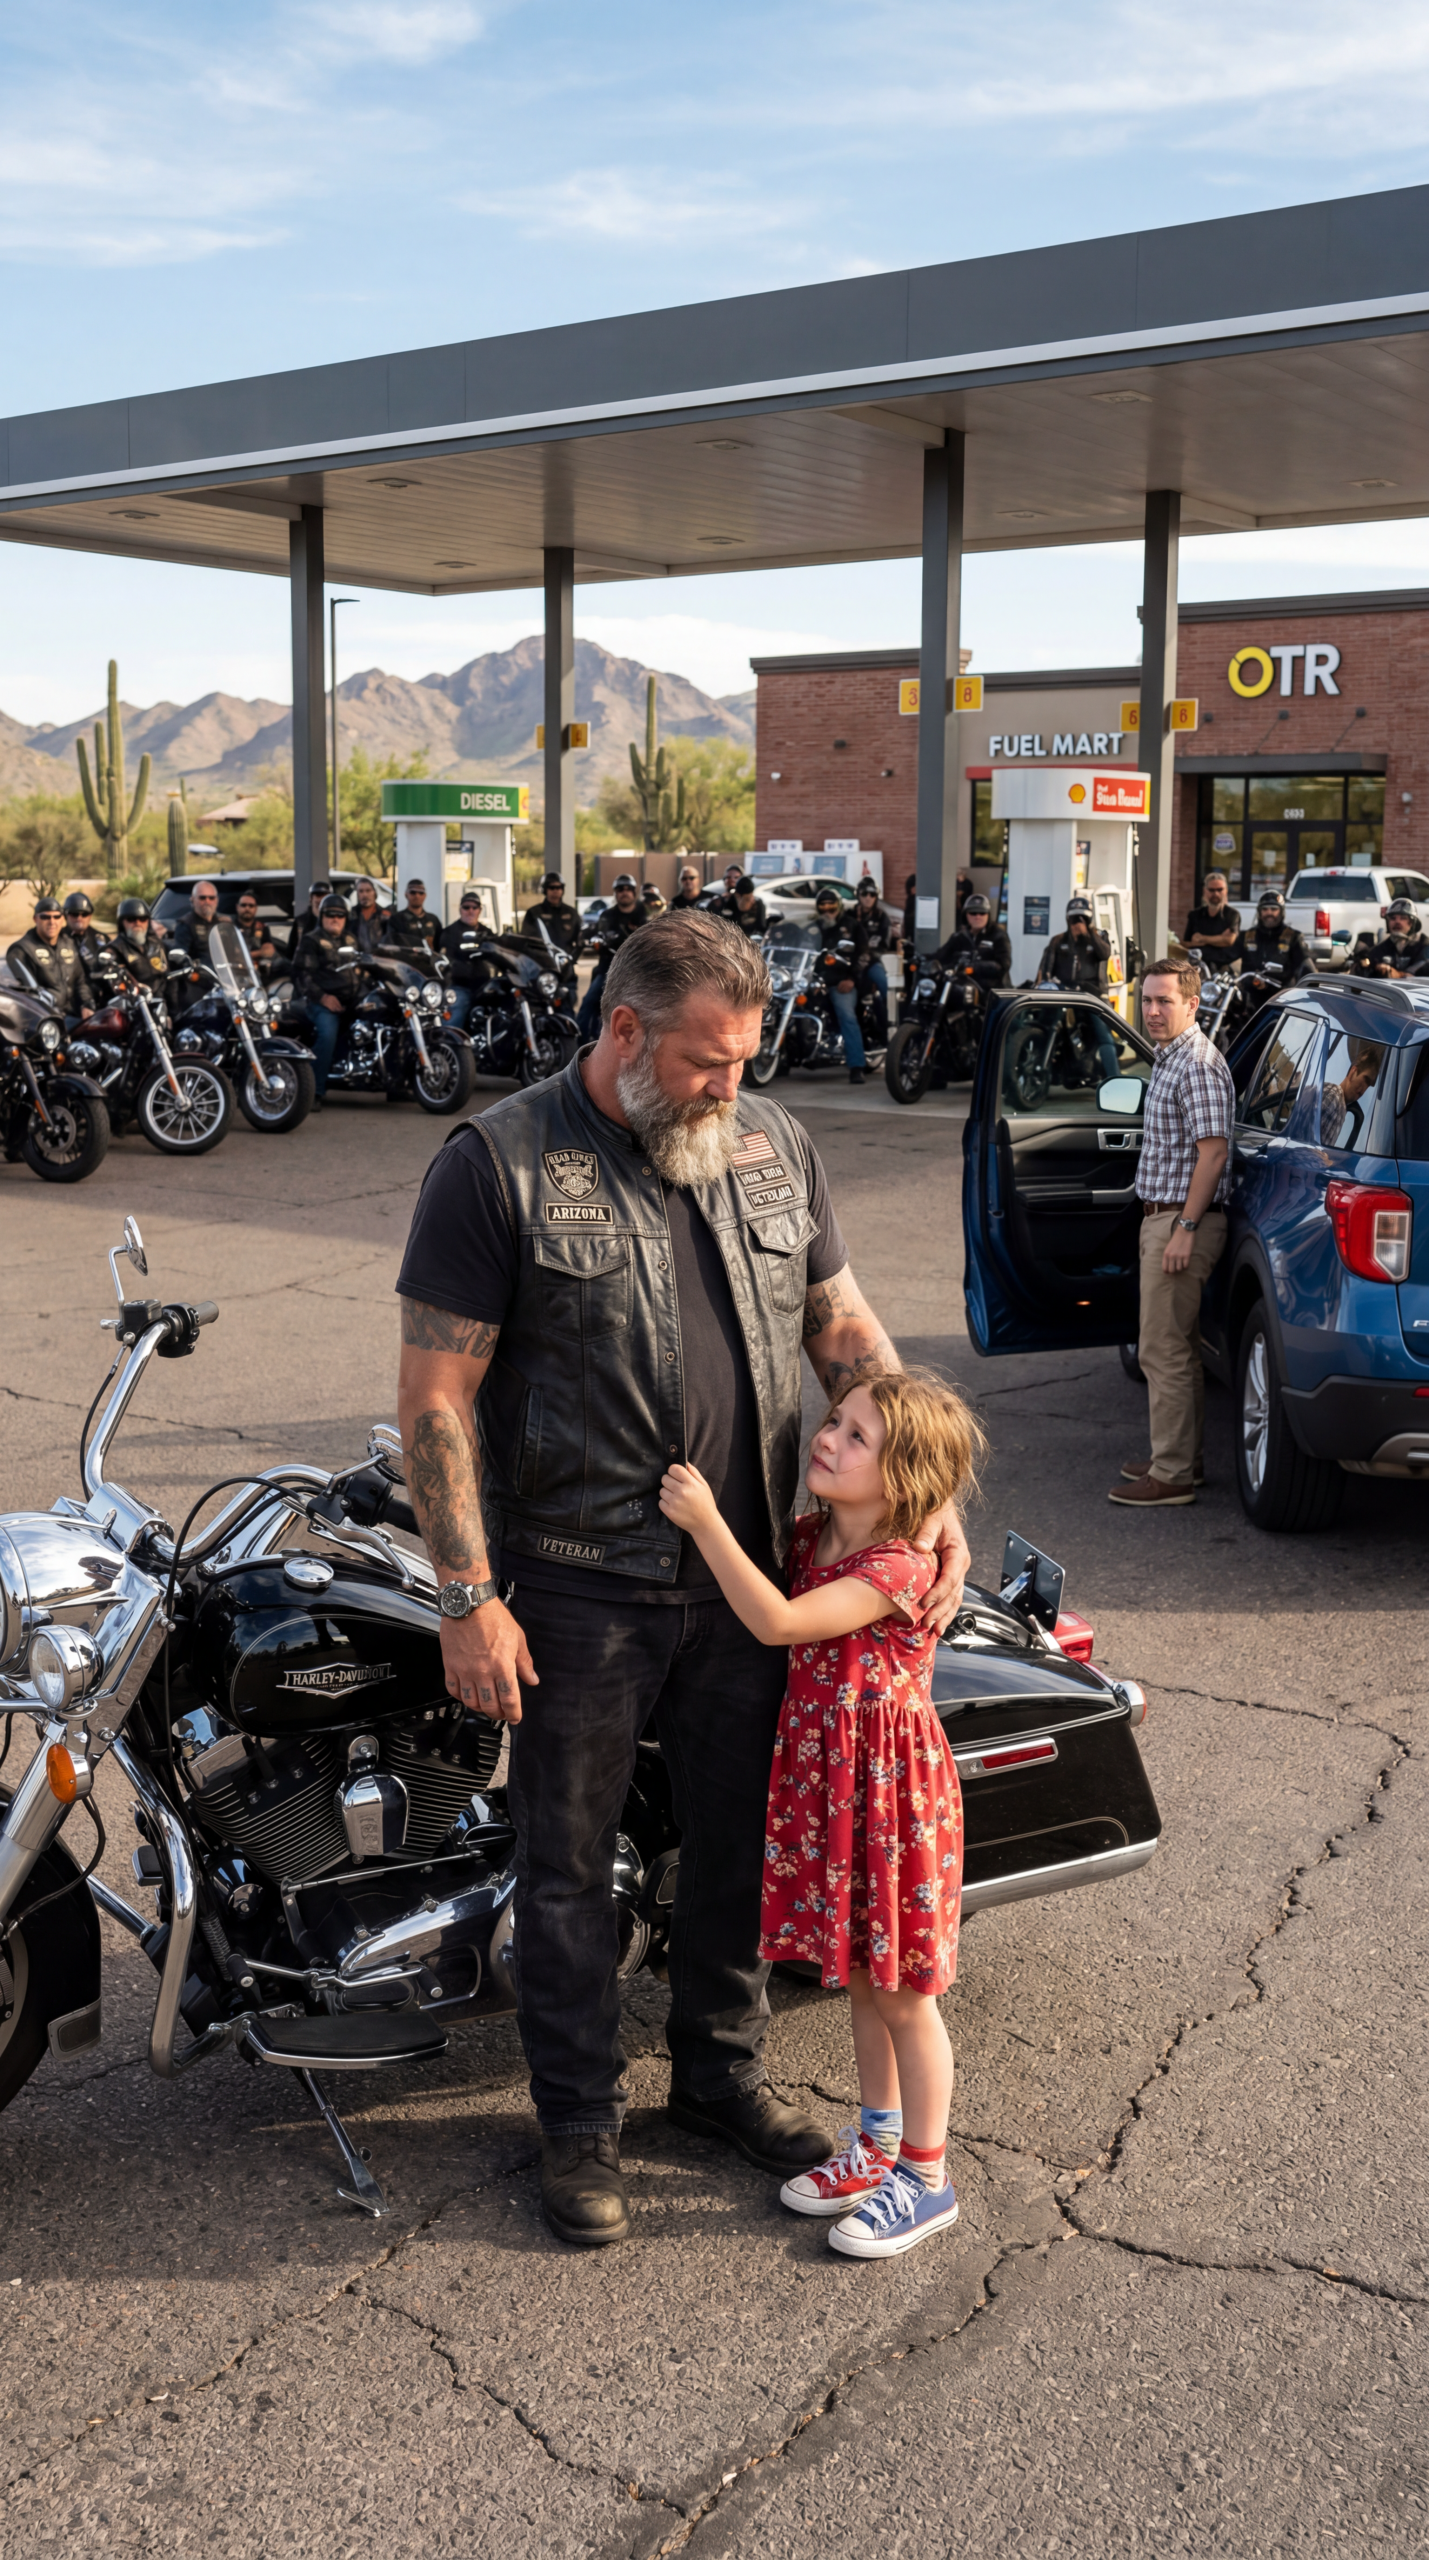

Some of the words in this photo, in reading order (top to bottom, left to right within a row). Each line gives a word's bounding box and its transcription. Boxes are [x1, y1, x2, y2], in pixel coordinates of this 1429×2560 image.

[1228, 643, 1341, 698] OTR
[1129, 709, 1138, 725] 6
[989, 734, 1047, 757] FUEL
[1052, 732, 1123, 756] MART
[460, 792, 511, 811] DIESEL
[552, 1207, 606, 1220] ARIZONA
[542, 1537, 601, 1561] VETERAN
